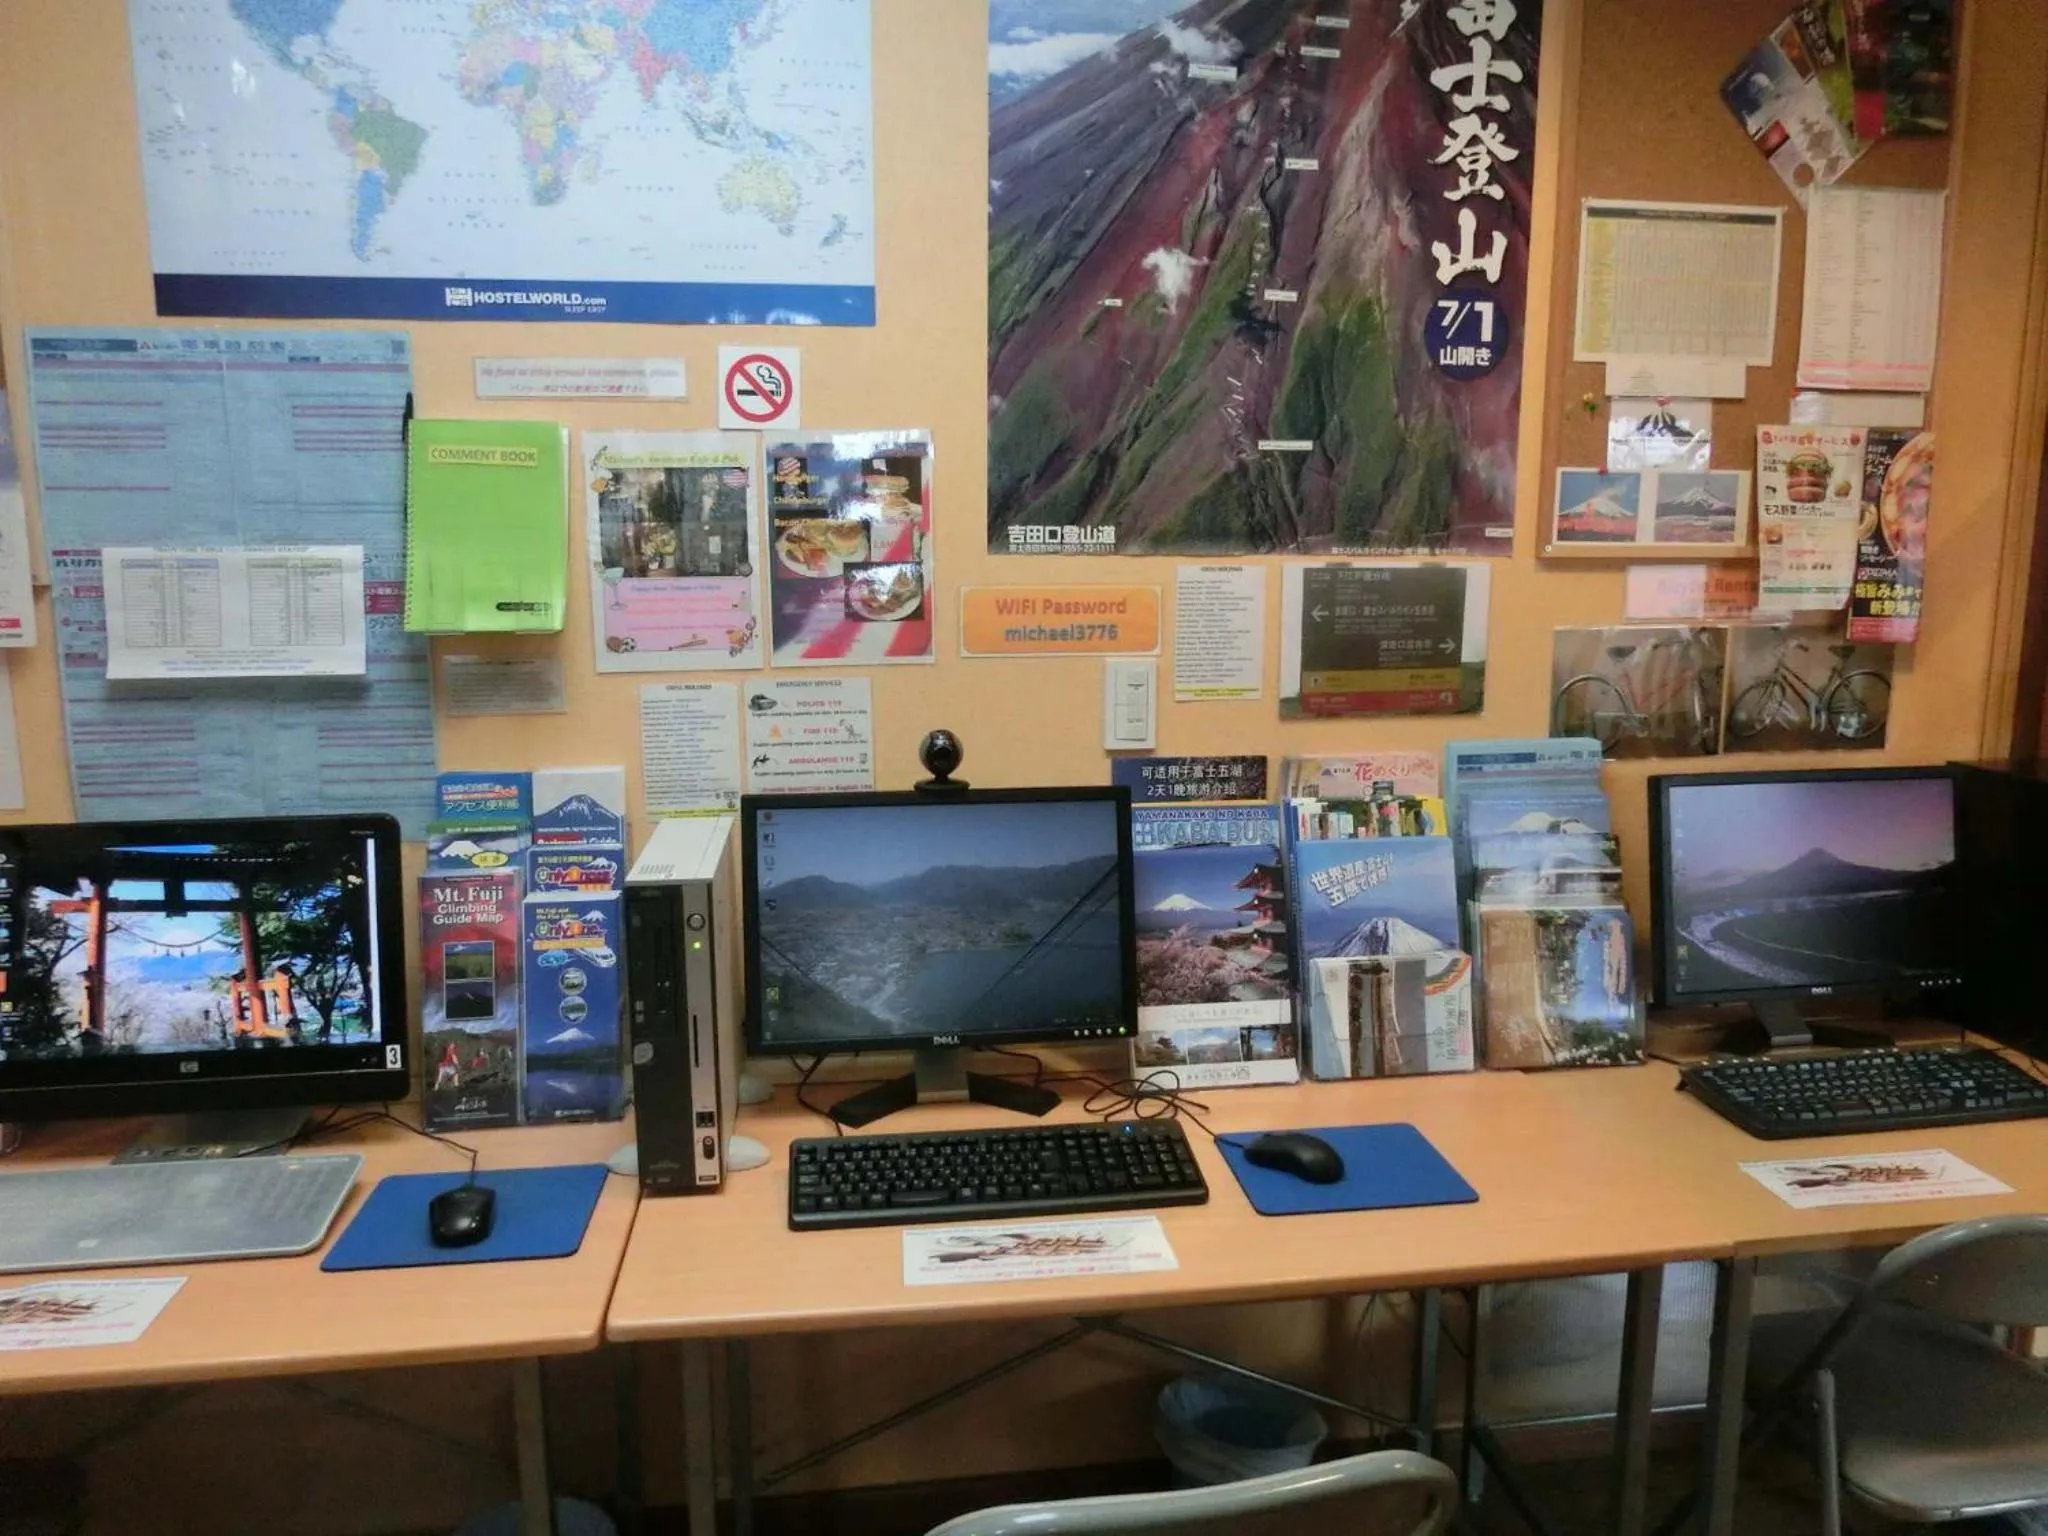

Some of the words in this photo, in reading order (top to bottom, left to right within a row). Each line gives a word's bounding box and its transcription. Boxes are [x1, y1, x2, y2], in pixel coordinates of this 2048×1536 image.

[474, 291, 607, 306] HOSTELWORLD.com
[1437, 300, 1495, 341] 7/1
[1439, 346, 1493, 366] 山開き
[431, 447, 497, 460] COMMENT
[500, 449, 536, 462] BOOK
[1007, 524, 1116, 544] 吉田口登山道
[1042, 598, 1127, 615] Password
[1004, 624, 1119, 642] michael3776
[433, 887, 465, 902] Mt.
[468, 885, 504, 903] Fuji
[437, 902, 497, 914] Climbing
[432, 913, 473, 925] Guide
[476, 912, 504, 924] Map
[389, 1047, 398, 1065] 3
